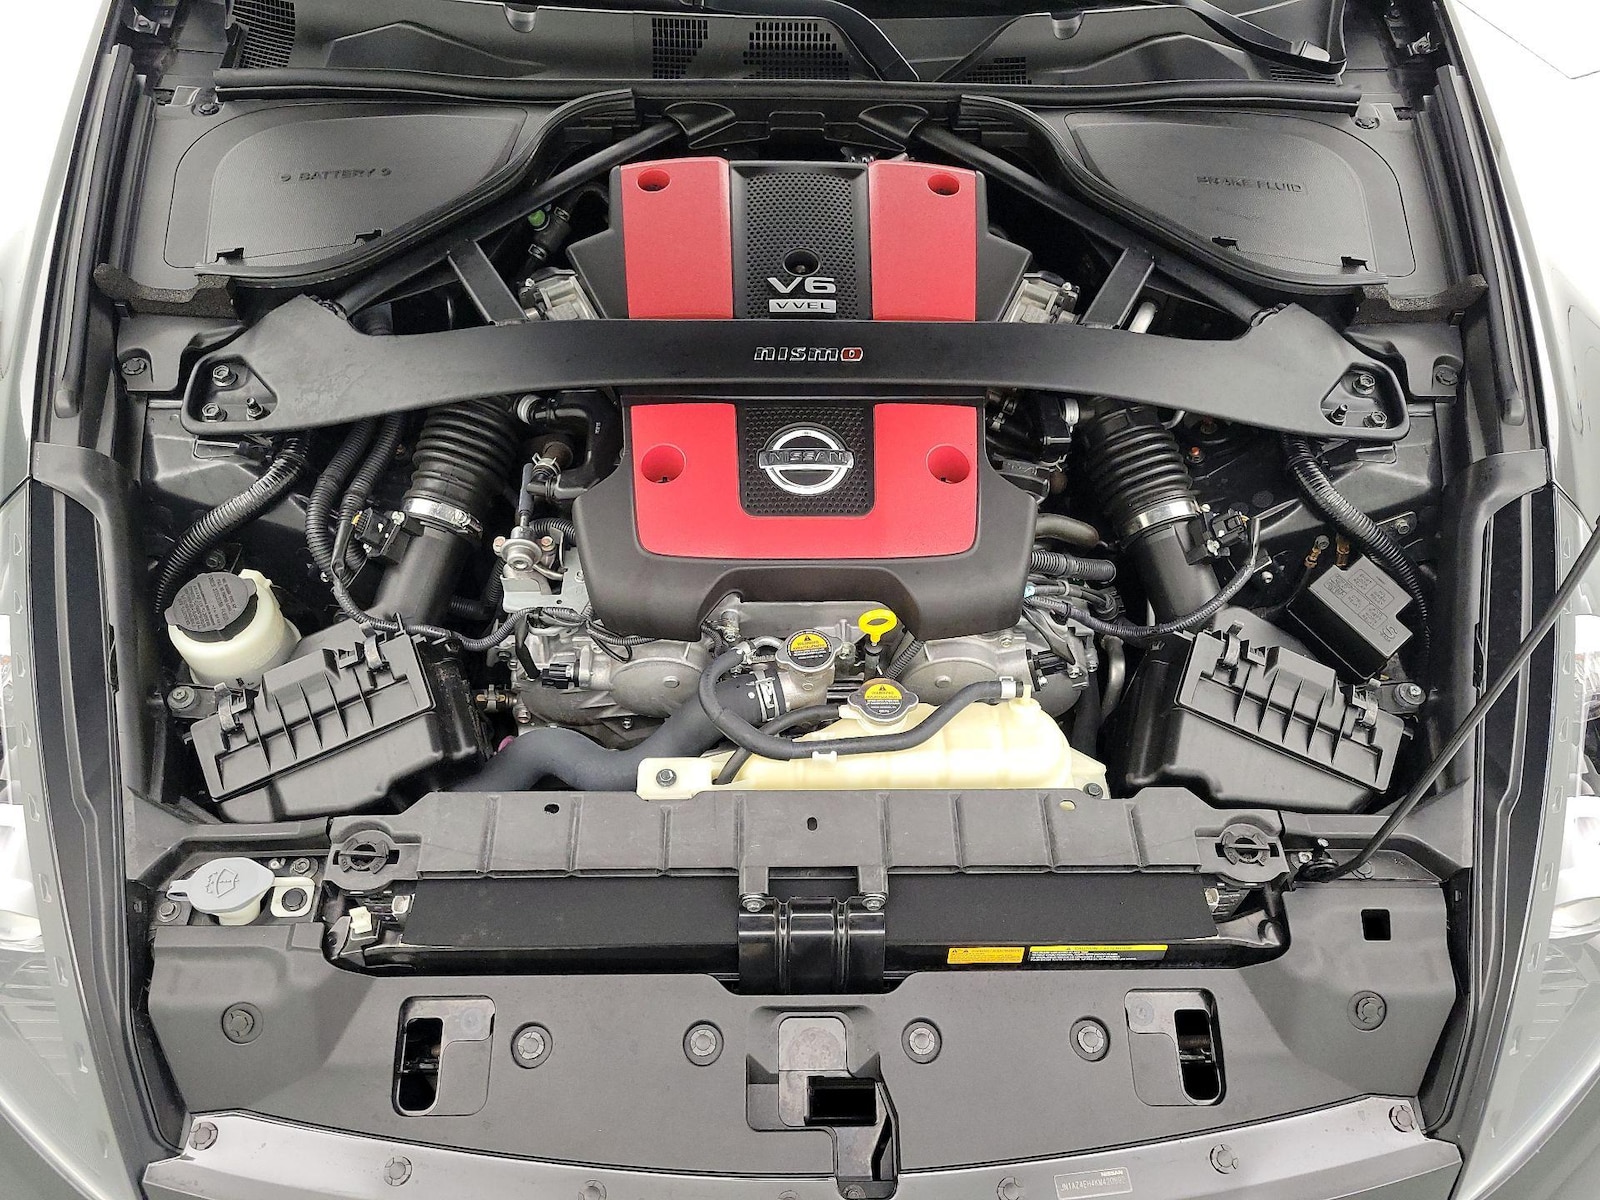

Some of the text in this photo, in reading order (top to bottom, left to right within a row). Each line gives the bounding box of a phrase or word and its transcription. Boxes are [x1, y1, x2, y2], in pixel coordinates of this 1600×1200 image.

[299, 168, 376, 181] BATTERY
[1197, 176, 1303, 193] BRAKE FLUID
[766, 276, 837, 294] V6
[774, 301, 832, 311] VVEL
[769, 450, 846, 463] NISSAN
